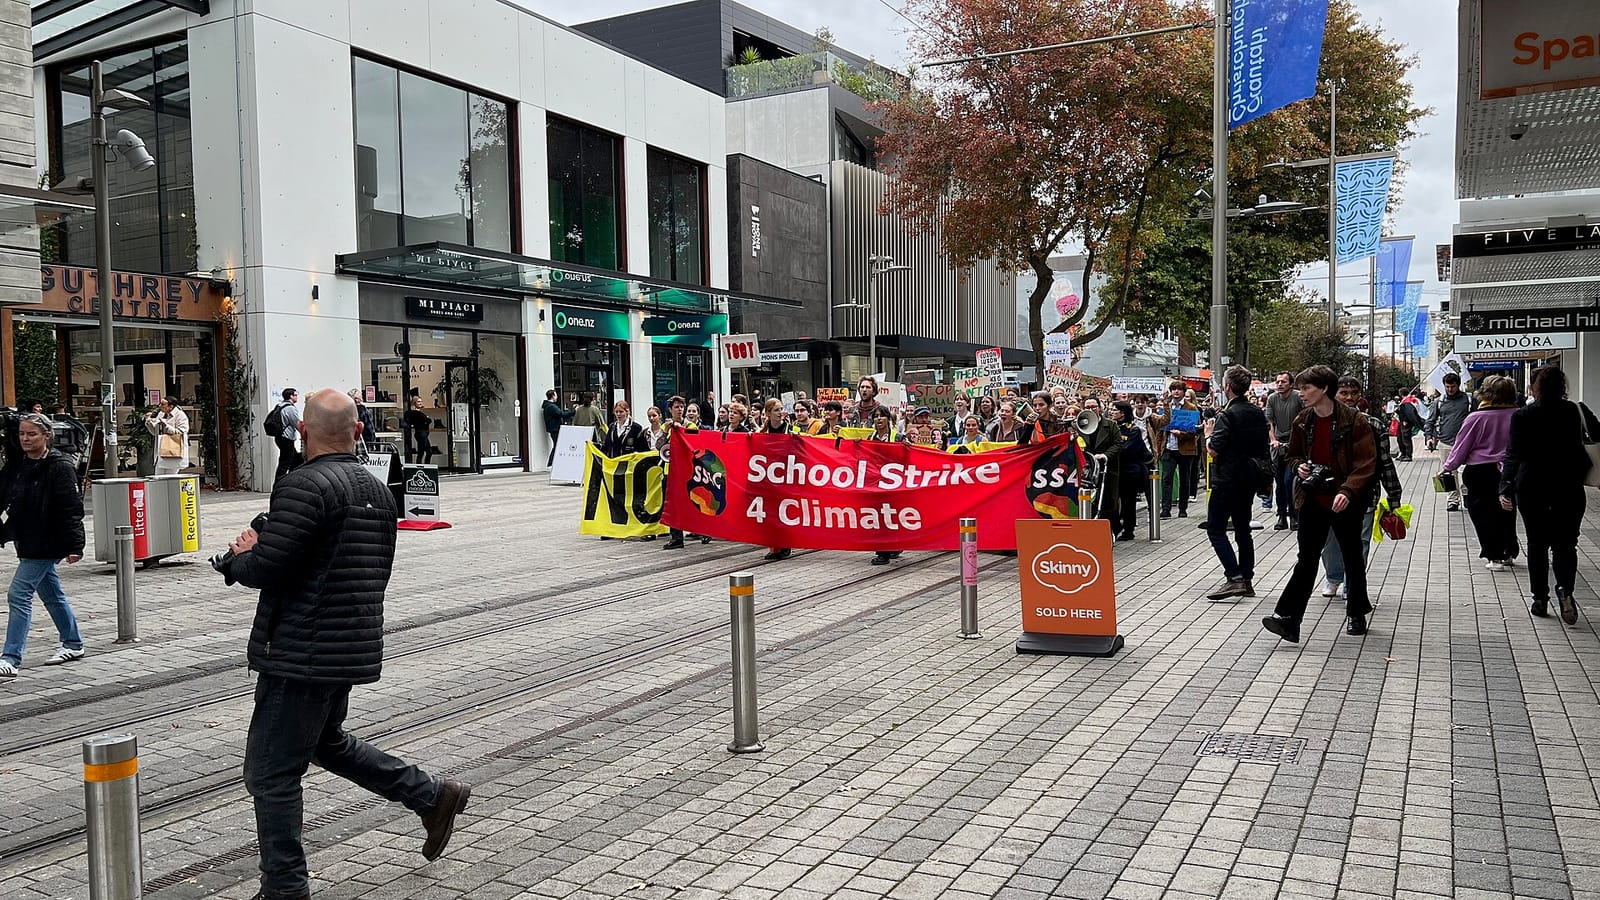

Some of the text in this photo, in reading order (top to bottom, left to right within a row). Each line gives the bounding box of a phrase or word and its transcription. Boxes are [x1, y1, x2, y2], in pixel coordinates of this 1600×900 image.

[1512, 32, 1600, 70] Spa
[1484, 226, 1600, 245] FIVE LA
[419, 299, 476, 312] MI PIACI
[567, 316, 595, 328] one.nz
[677, 321, 701, 330] one.nz
[1488, 313, 1570, 330] michael
[725, 342, 754, 360] TOOT
[761, 353, 802, 361] MONS ROYALE
[396, 364, 432, 374] PACI
[915, 385, 953, 398] STOP
[964, 378, 978, 388] NO
[746, 454, 1000, 490] School Strike
[584, 454, 664, 524] NO
[134, 504, 145, 537] Litter
[183, 490, 196, 541] Recycling
[746, 496, 922, 530] 4 Climate
[1039, 560, 1092, 578] Skinny
[1035, 607, 1102, 619] SOLD HERE
